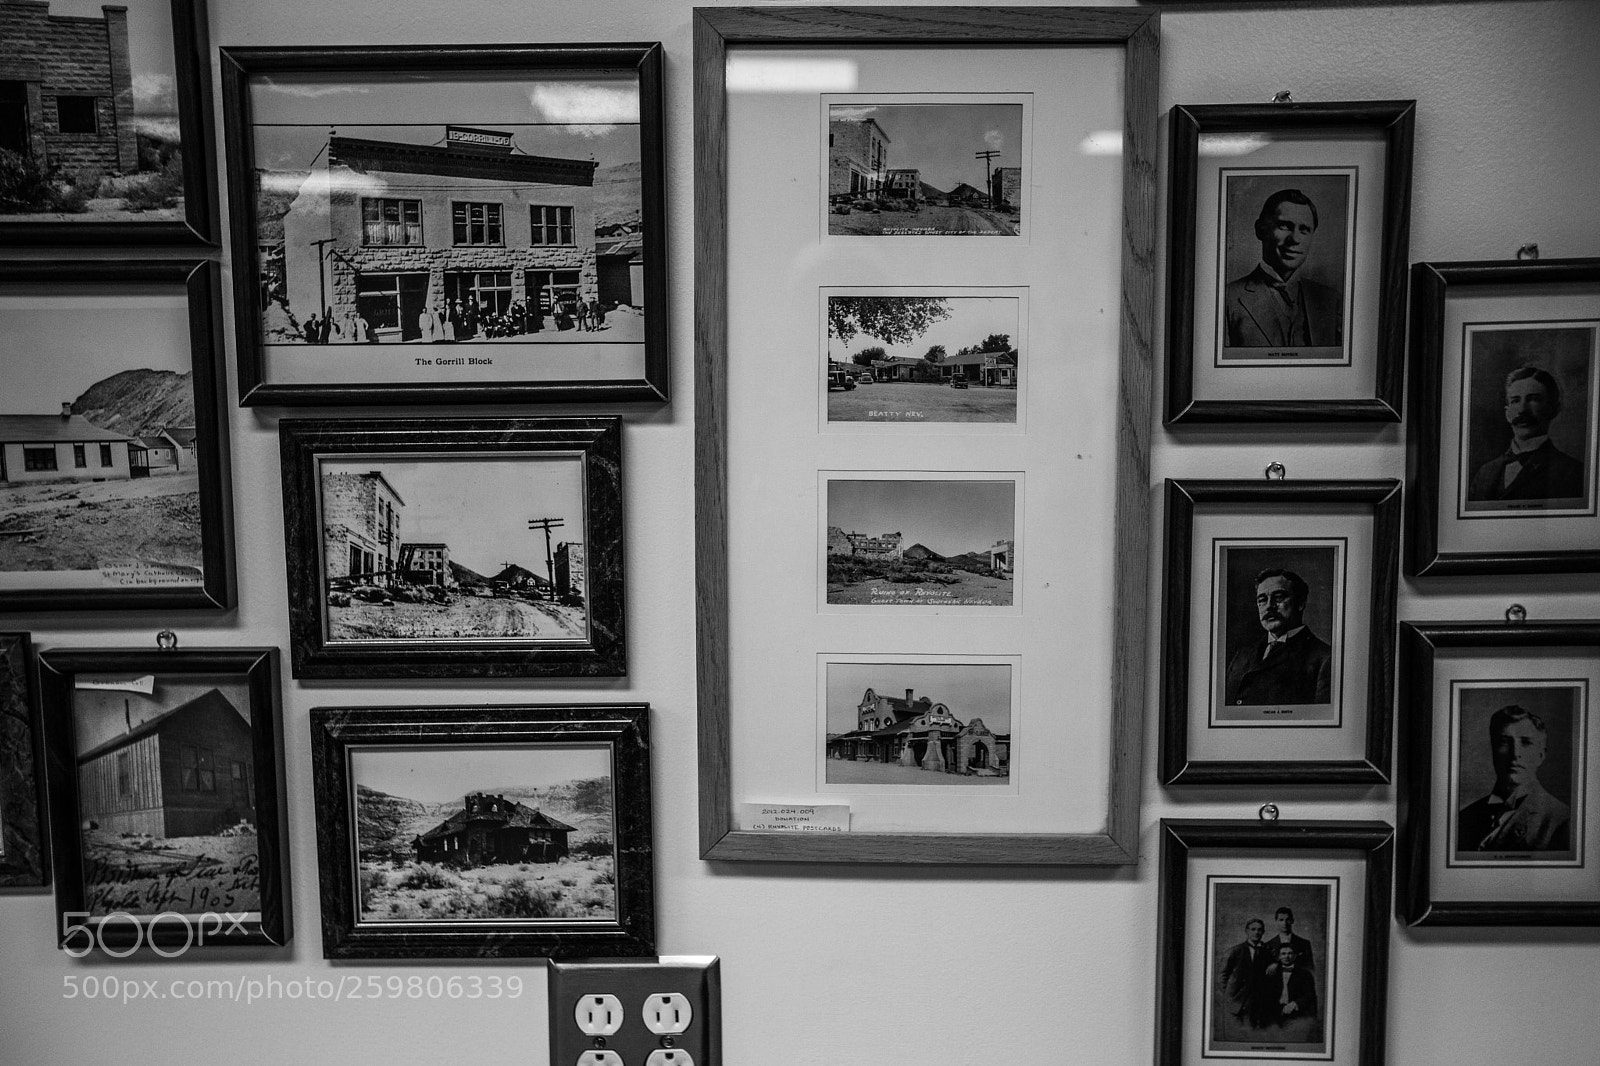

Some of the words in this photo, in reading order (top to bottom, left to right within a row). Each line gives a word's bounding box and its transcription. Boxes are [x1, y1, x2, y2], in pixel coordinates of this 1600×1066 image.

[414, 357, 432, 365] The
[435, 357, 465, 365] Gorrill
[468, 357, 493, 365] Block
